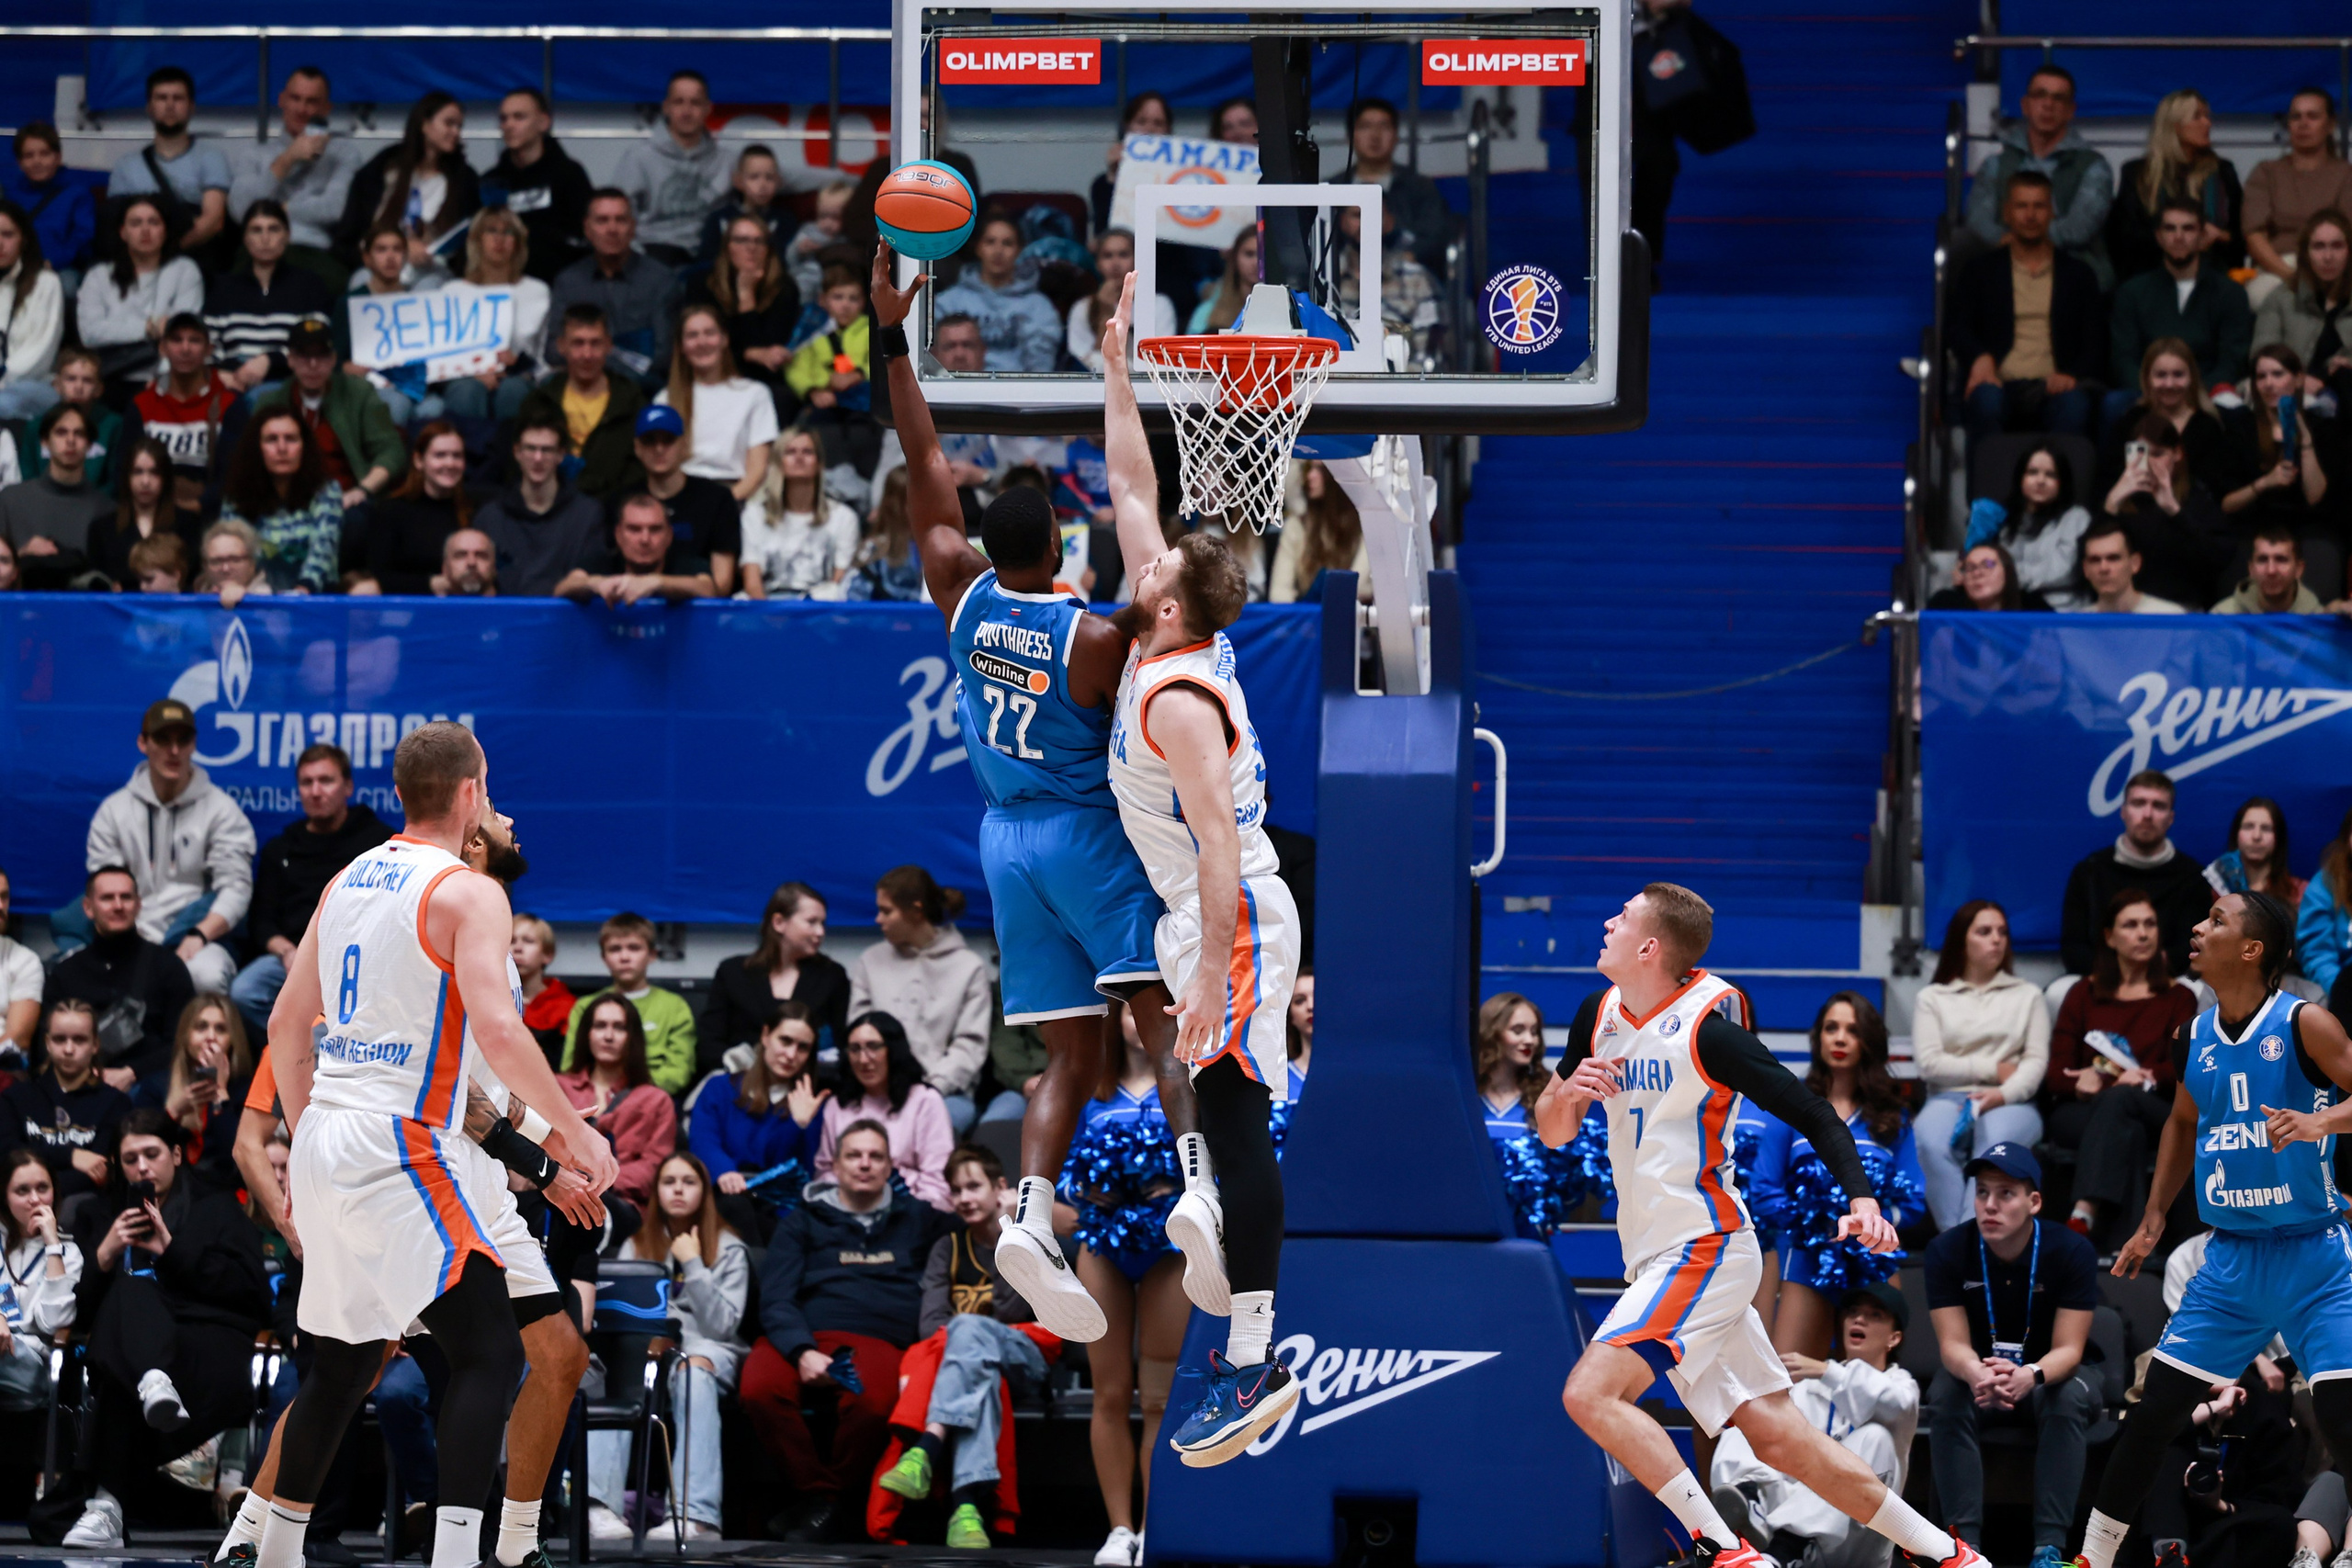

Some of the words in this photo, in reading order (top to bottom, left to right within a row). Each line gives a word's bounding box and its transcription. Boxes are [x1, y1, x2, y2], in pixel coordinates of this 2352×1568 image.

[945, 52, 1094, 71] OLIMPBET
[1429, 53, 1578, 72] OLIMPBET
[1126, 137, 1262, 174] САМАР
[1485, 265, 1521, 293] ЕДИНАЯ
[1521, 265, 1547, 279] ЛИГА
[1546, 276, 1563, 293] ВТБ
[362, 294, 511, 361] ЗЕНИТ
[1485, 325, 1499, 344] VTB
[1498, 340, 1531, 355] UNITED
[1532, 325, 1563, 353] LEAGUE
[973, 620, 1053, 661] POYTHRESS
[976, 656, 1025, 685] Winline
[983, 683, 1045, 761] 22
[258, 713, 476, 768] ГАЗПР
[339, 944, 361, 1025] 8
[1604, 1059, 1675, 1094] AMARA
[2230, 1072, 2250, 1112] 0
[1629, 1108, 1644, 1150] 7
[2204, 1122, 2270, 1152] ZENI
[2229, 1183, 2294, 1208] ГАЗПРОМ
